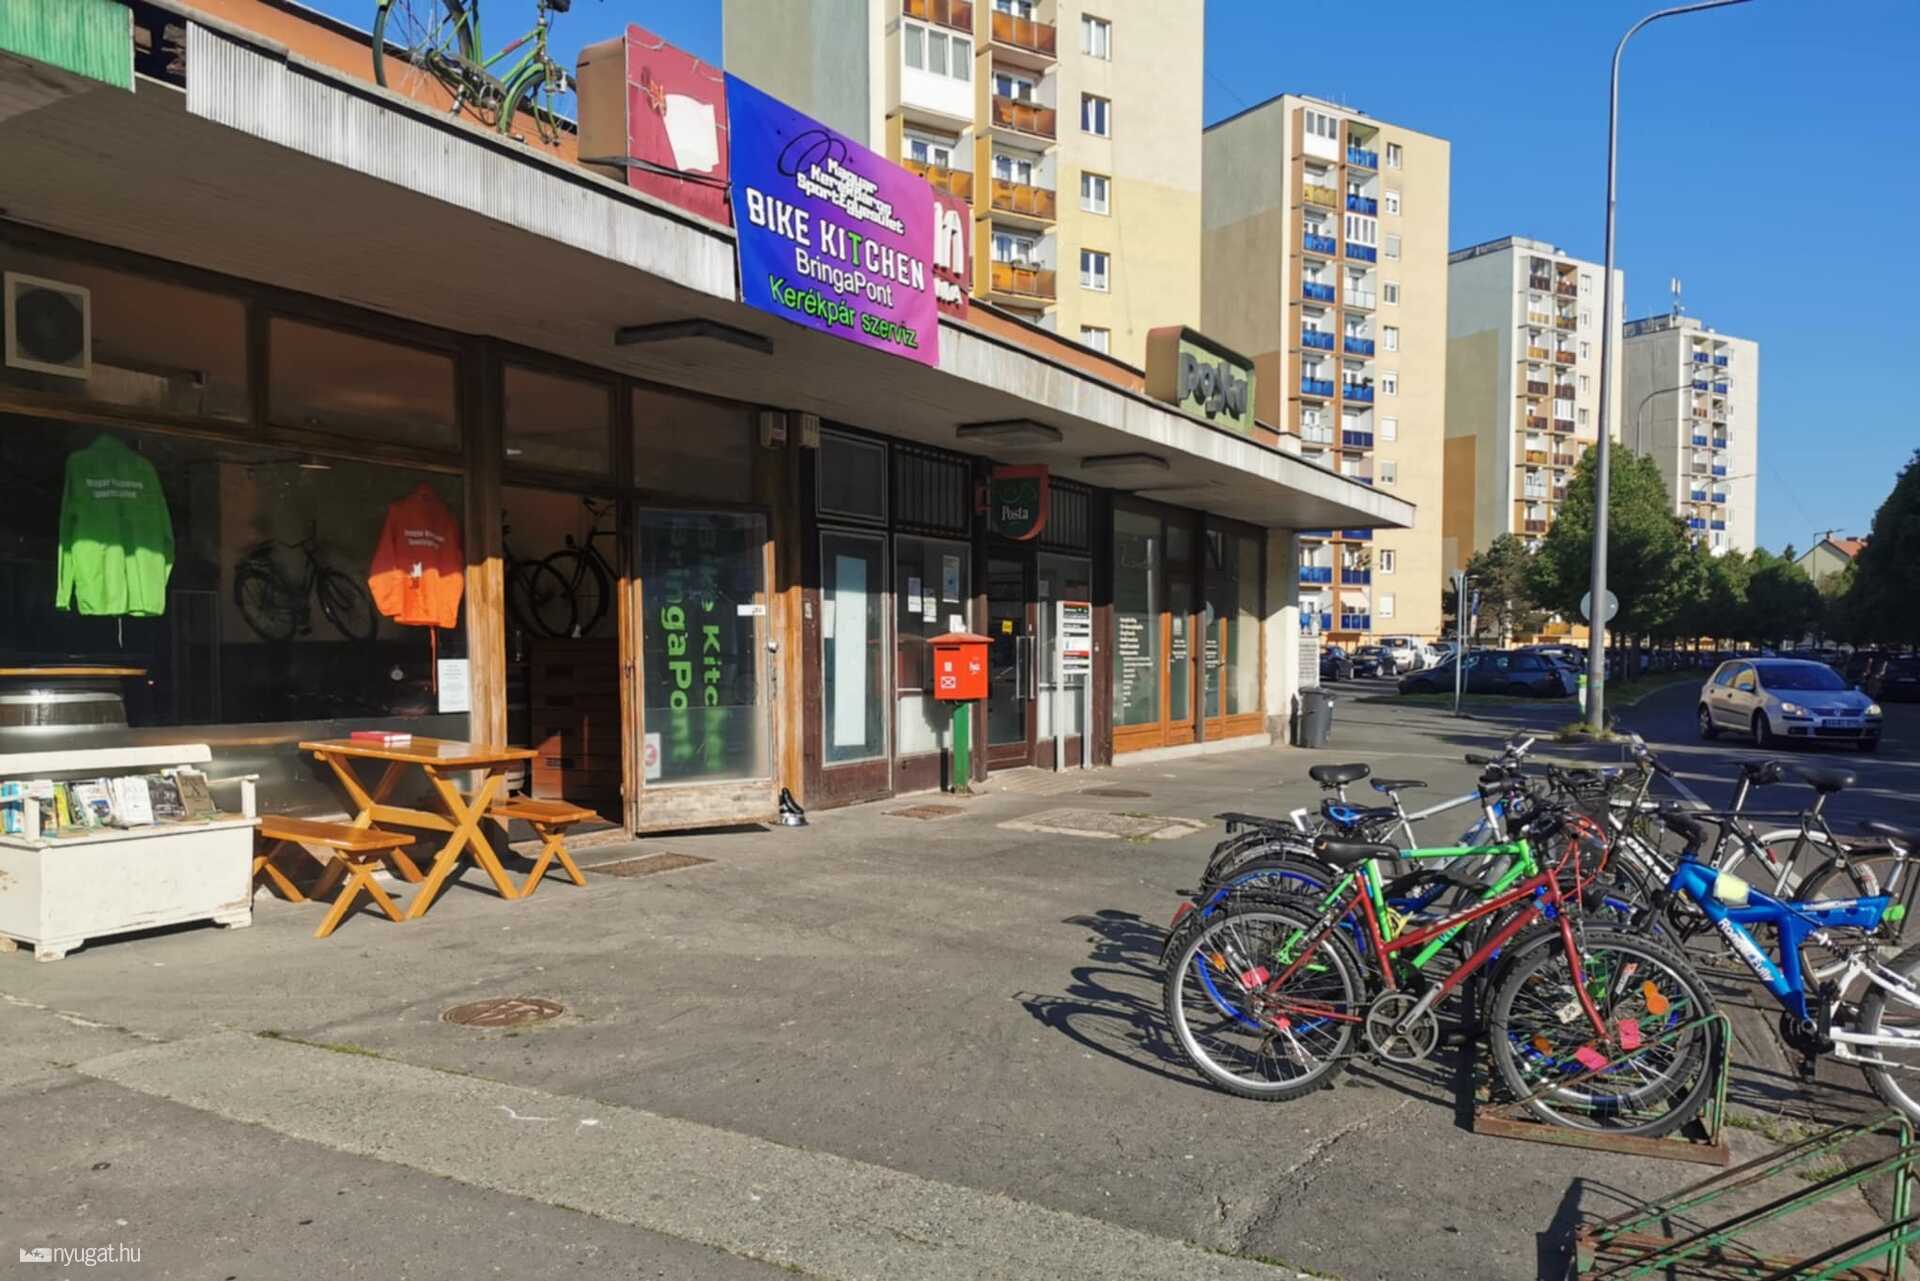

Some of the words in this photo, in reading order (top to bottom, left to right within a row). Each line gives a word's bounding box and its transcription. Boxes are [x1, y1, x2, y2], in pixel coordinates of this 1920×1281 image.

[746, 187, 811, 247] BIKE
[820, 219, 925, 291] KITCHEN
[795, 247, 893, 307] BringaPont
[769, 274, 856, 326] Kerékpár
[861, 313, 918, 347] szerviz
[1001, 505, 1029, 521] Posta
